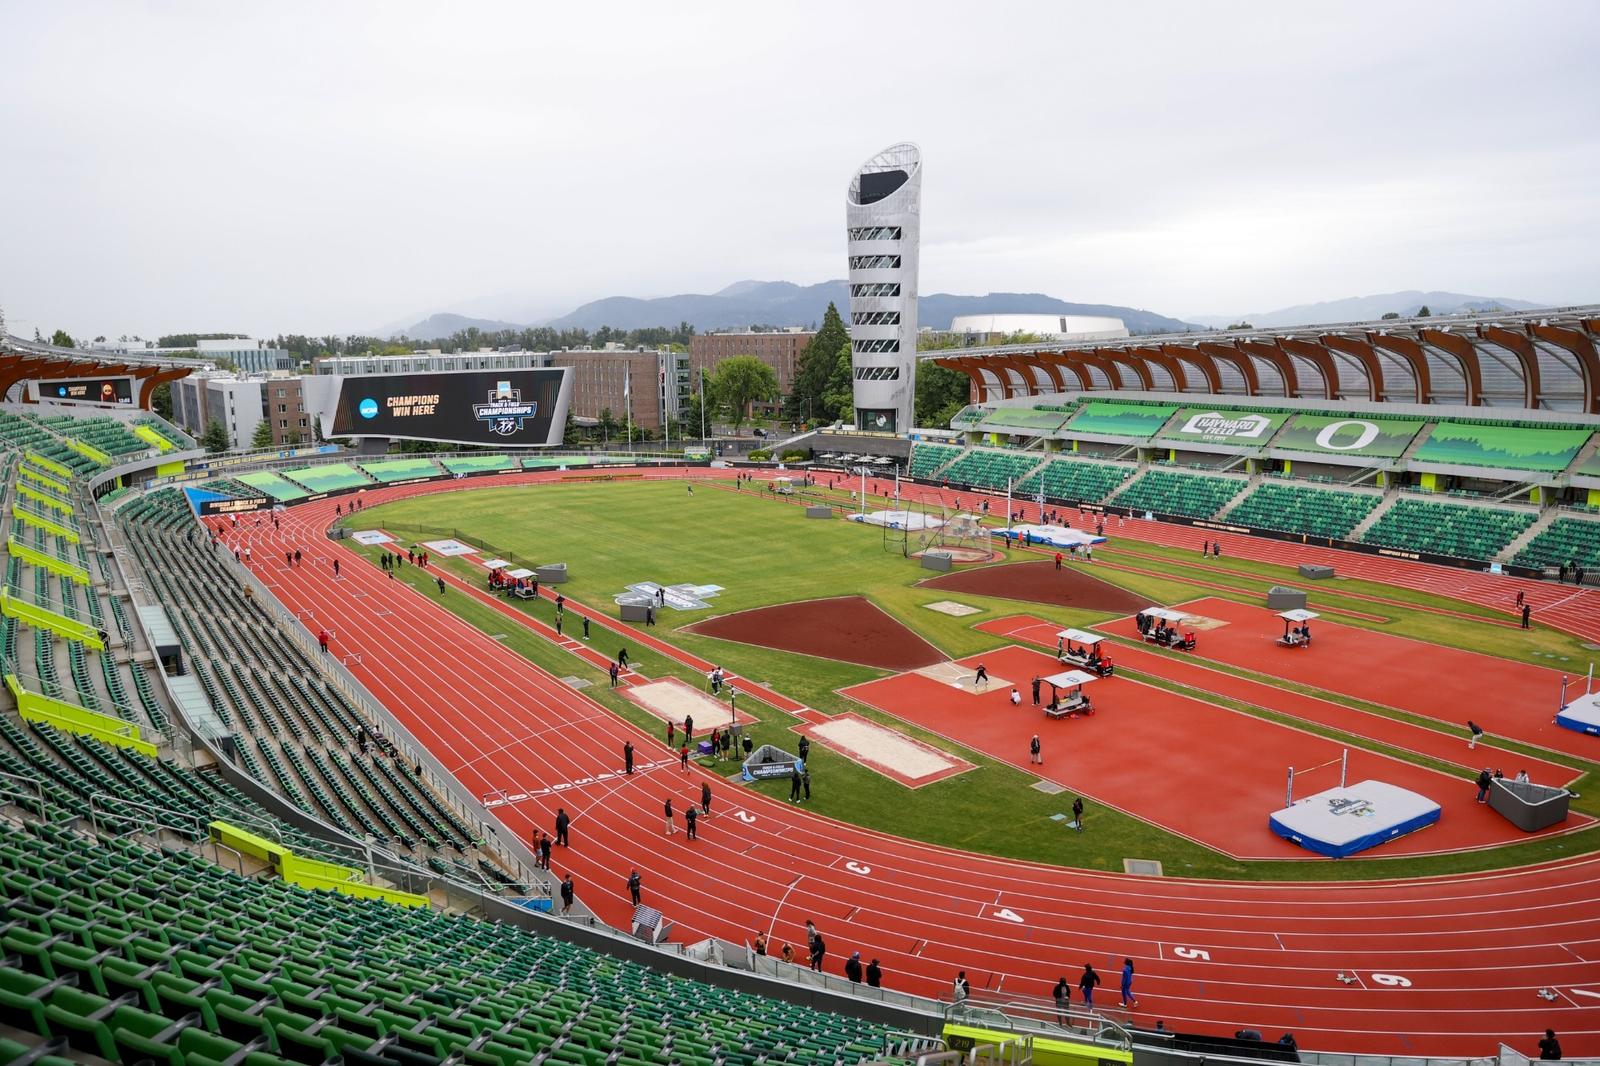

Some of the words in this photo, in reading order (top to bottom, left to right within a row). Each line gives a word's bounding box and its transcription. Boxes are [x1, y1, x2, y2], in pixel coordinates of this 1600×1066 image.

[386, 394, 440, 407] CHAMPIONS
[392, 406, 410, 417] WIN
[412, 405, 435, 416] HERE
[479, 406, 532, 416] CHAMPIONSHIPS
[1197, 418, 1256, 430] HAYWARD
[1204, 427, 1237, 436] FIELD
[1315, 420, 1380, 451] O
[574, 777, 594, 785] 5
[507, 793, 528, 801] 8
[733, 810, 757, 823] 2
[845, 861, 871, 875] 3
[993, 908, 1025, 923] 4
[1173, 946, 1211, 961] 5
[1371, 973, 1412, 987] 6
